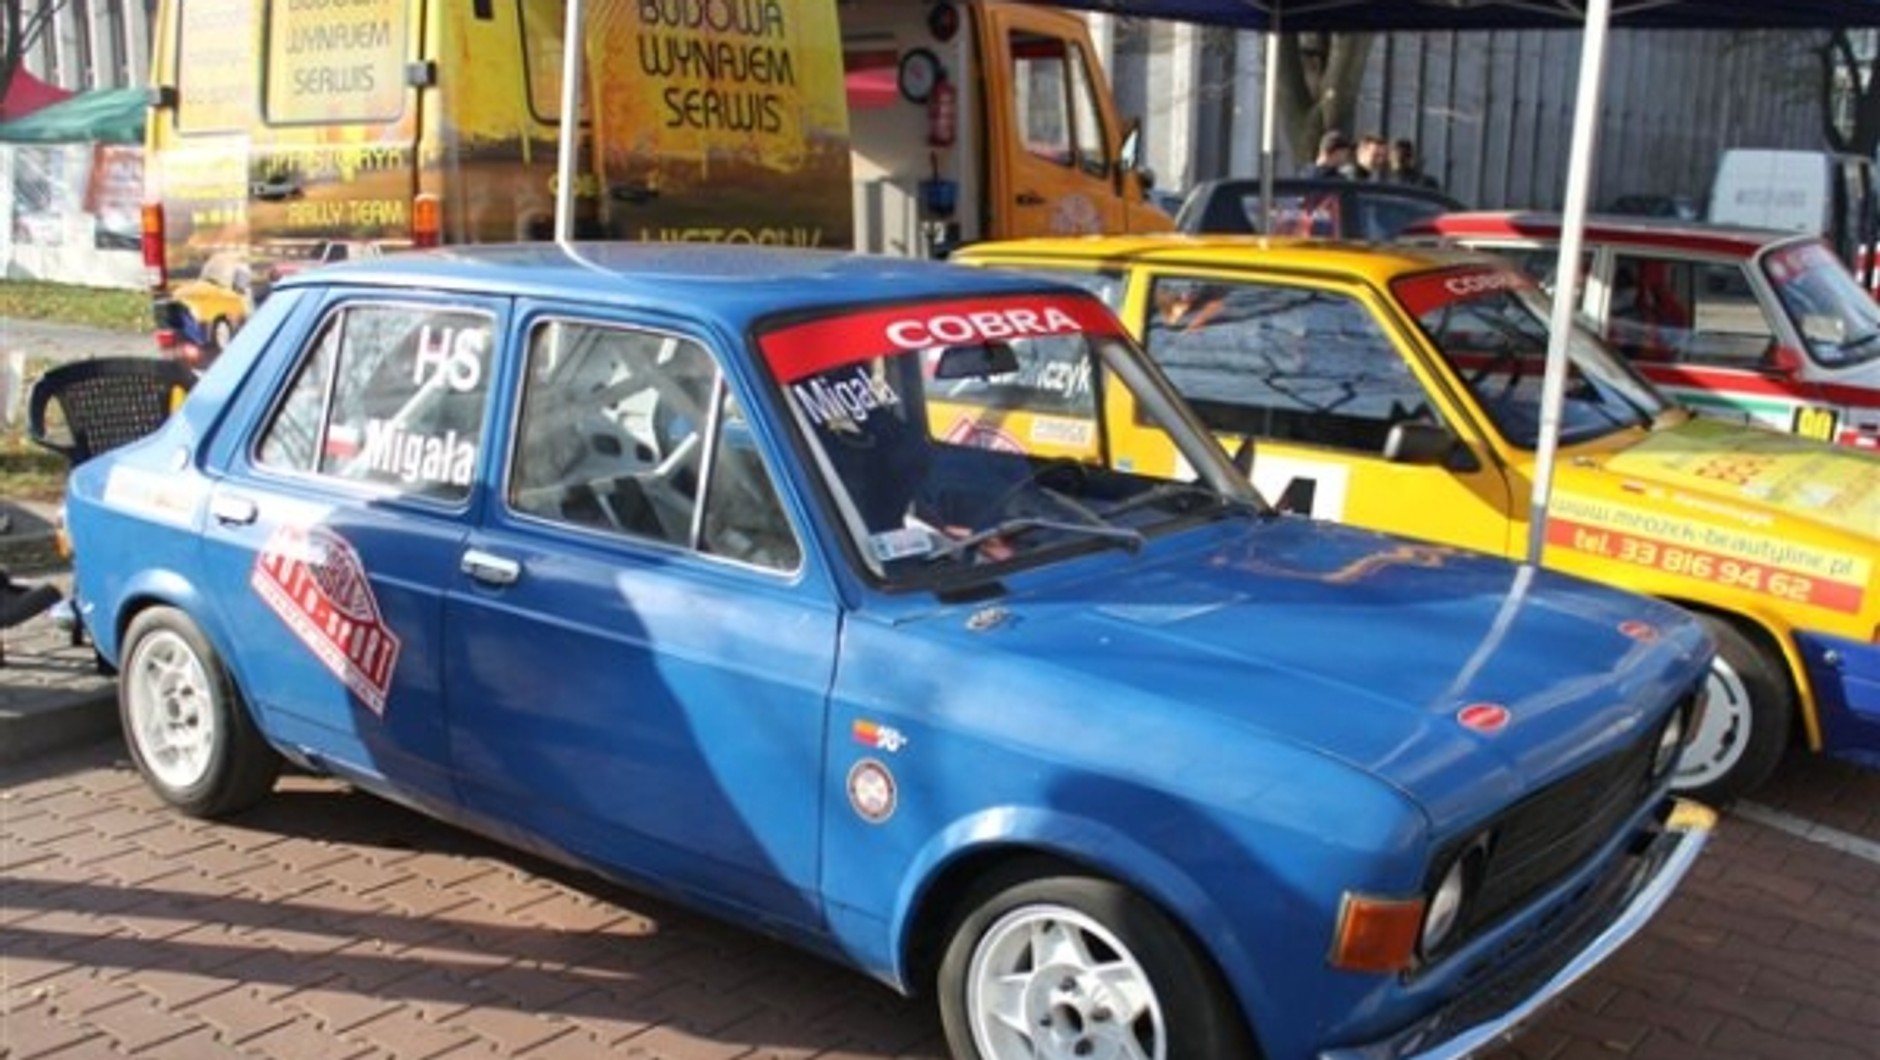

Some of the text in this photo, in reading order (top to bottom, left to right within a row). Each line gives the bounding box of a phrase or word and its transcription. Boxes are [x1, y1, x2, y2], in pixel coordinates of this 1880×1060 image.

[294, 64, 376, 95] SERWIS
[636, 33, 794, 86] WYNAJEM
[664, 87, 782, 133] SERWIS
[350, 200, 405, 226] TEAM
[886, 307, 1082, 349] COBRA
[414, 325, 484, 392] HS
[366, 418, 475, 487] Migała
[1573, 528, 1813, 601] tel. 33 816 94 62
